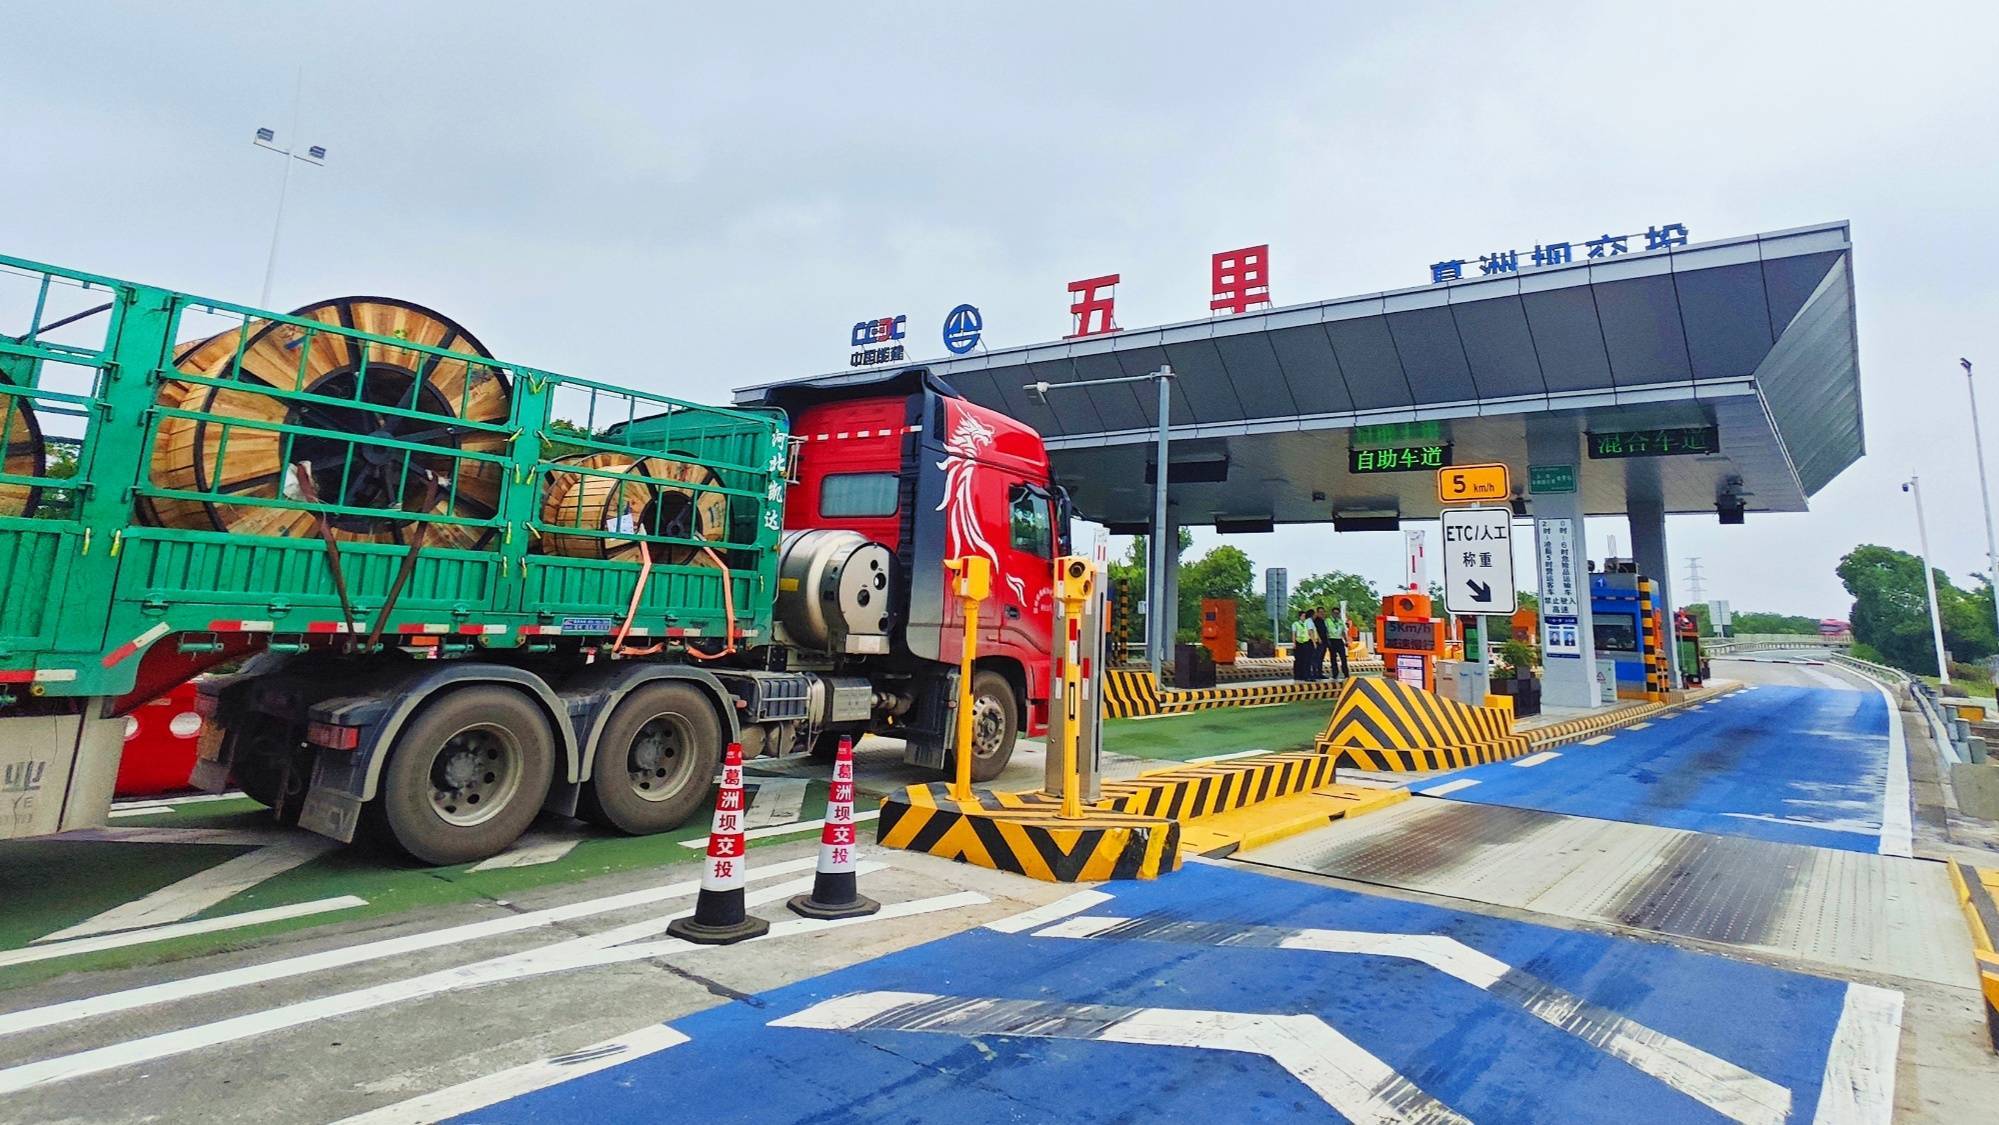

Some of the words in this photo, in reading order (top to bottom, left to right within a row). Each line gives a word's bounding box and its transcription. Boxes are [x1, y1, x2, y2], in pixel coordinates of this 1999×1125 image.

[850, 345, 904, 367] 中国能建
[1598, 428, 1708, 454] 混合车道
[1357, 446, 1443, 470] 自助车道
[1453, 475, 1466, 494] 5
[1473, 483, 1495, 493] km/h
[1446, 525, 1507, 541] ETC/人工
[1462, 552, 1493, 568] 称重
[1544, 597, 1576, 605] 禁止驶入
[714, 769, 740, 878] 葛洲坝交投
[832, 763, 852, 864] 葛洲坝交投
